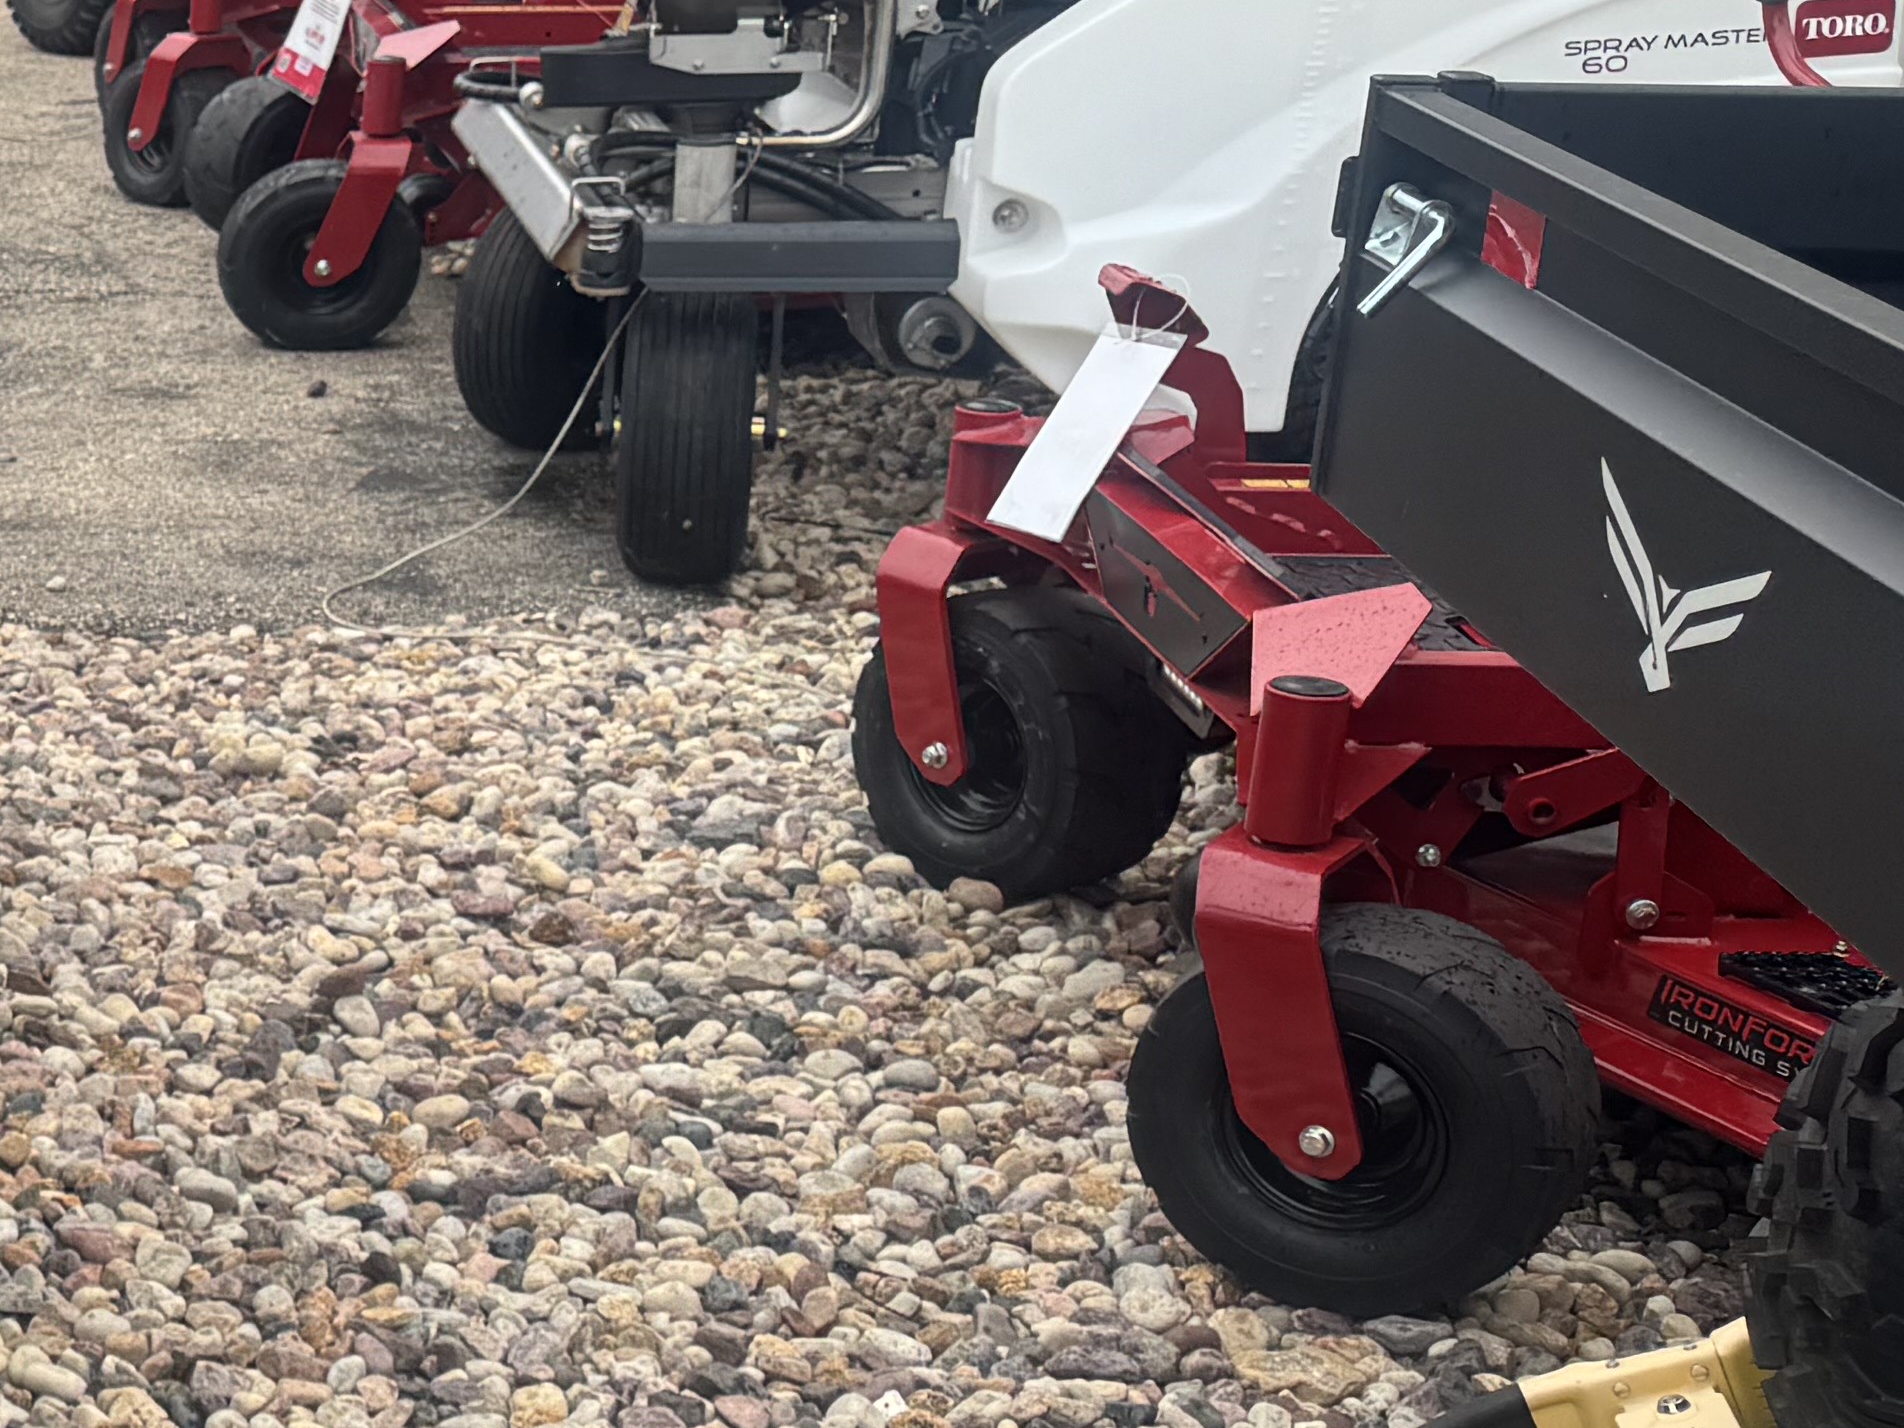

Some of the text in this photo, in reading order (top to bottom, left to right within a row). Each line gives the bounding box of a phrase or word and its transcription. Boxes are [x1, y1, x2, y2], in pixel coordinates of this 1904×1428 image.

[1802, 12, 1886, 40] TORO
[1564, 28, 1769, 57] SPRAY MASTE
[1581, 55, 1629, 74] 60
[1667, 1010, 1768, 1067] CUTTING
